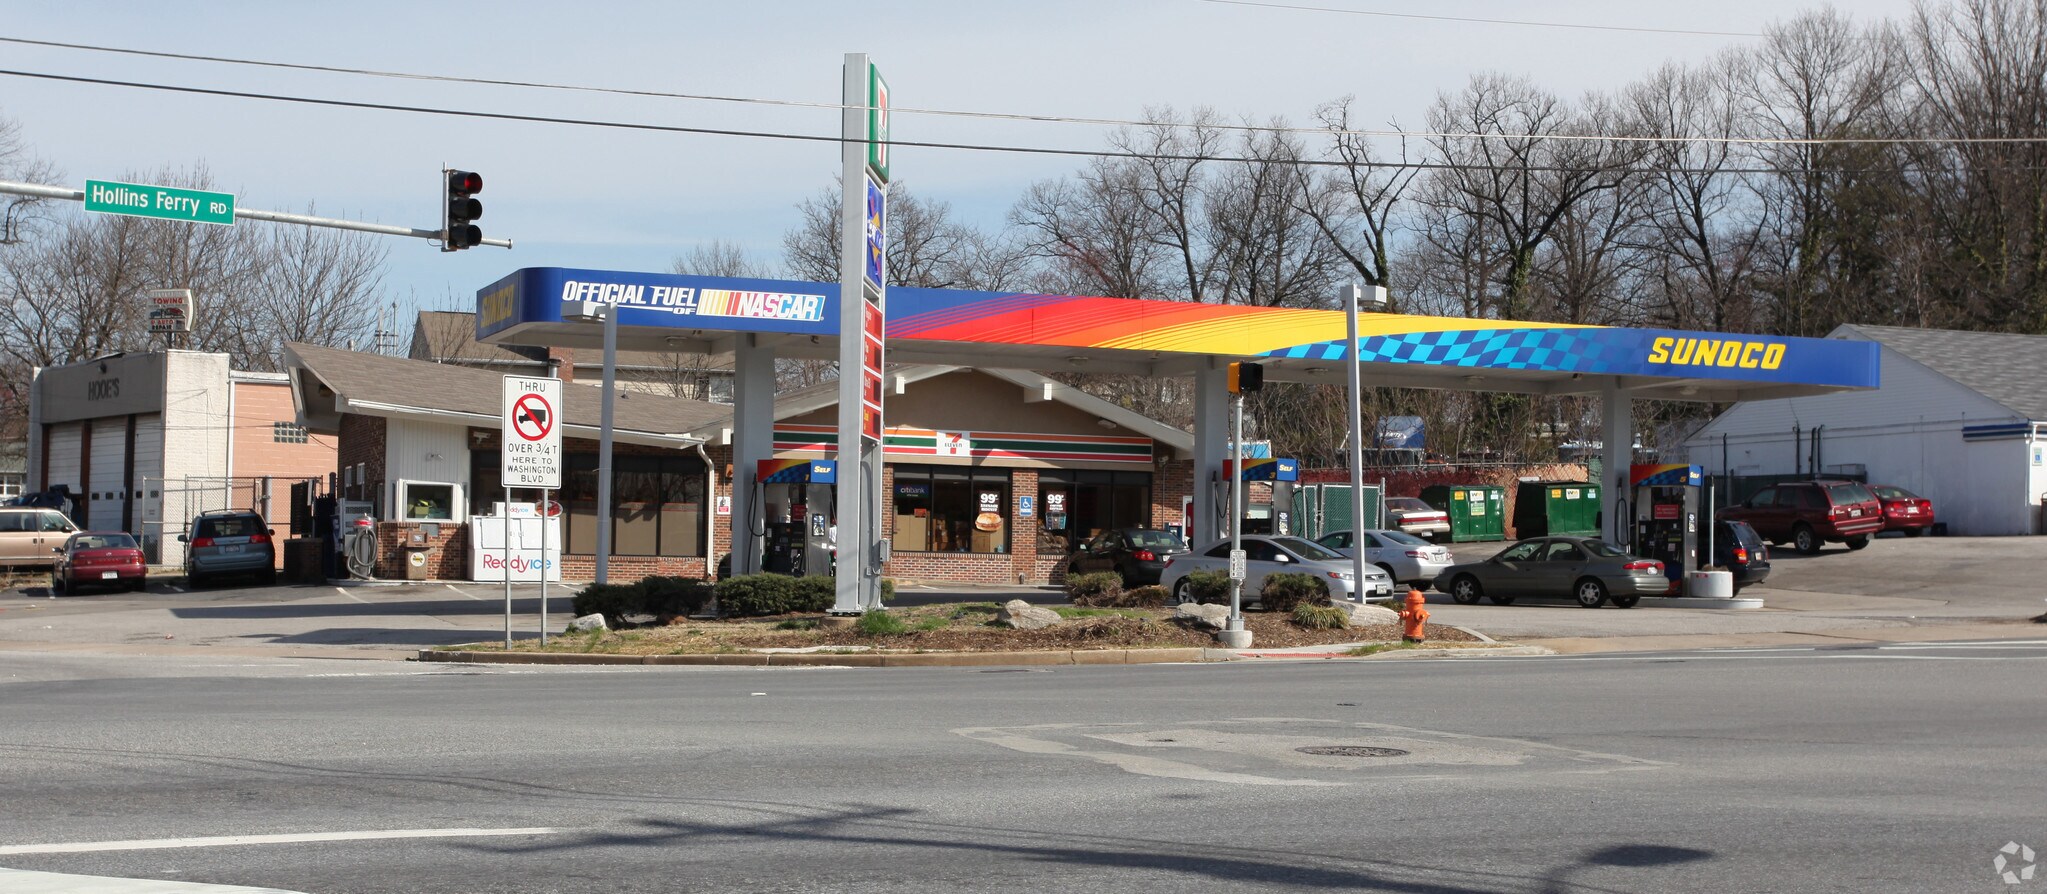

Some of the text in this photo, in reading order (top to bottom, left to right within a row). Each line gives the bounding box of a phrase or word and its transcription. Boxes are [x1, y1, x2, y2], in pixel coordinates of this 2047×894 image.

[92, 184, 227, 217] Hollins Ferry RD
[481, 283, 515, 329] SUNOCO
[562, 280, 820, 321] OFFICIAL FUEL OF NASCAR
[1648, 336, 1786, 370] SUNOCO
[519, 381, 546, 393] THRU
[508, 443, 558, 455] OVER 3/4 T
[512, 456, 553, 465] HERE TO
[507, 464, 557, 475] WASHINGTON
[520, 474, 544, 483] BLVD
